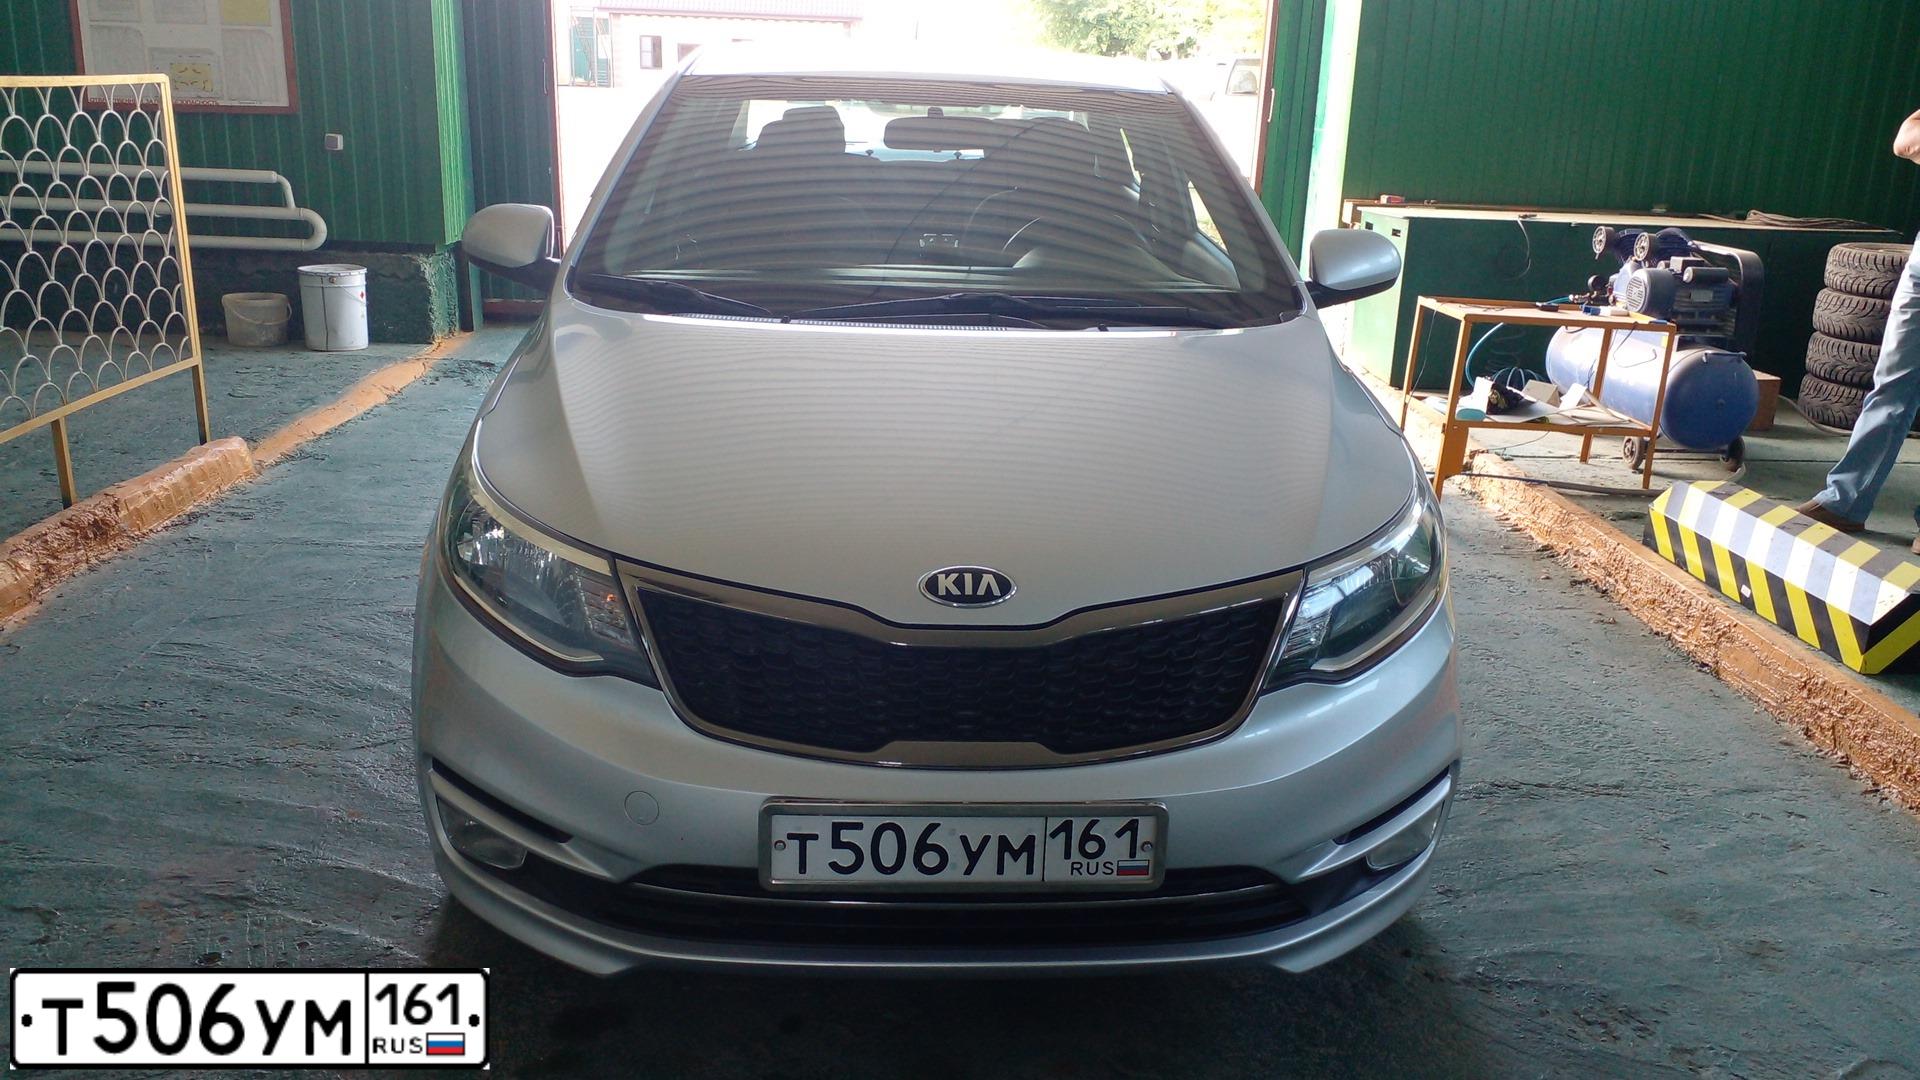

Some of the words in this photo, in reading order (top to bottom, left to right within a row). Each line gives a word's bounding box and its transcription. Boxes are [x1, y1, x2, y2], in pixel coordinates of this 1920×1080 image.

[937, 573, 1002, 596] KIA
[1049, 818, 1140, 860] 161
[1070, 861, 1114, 876] RUS
